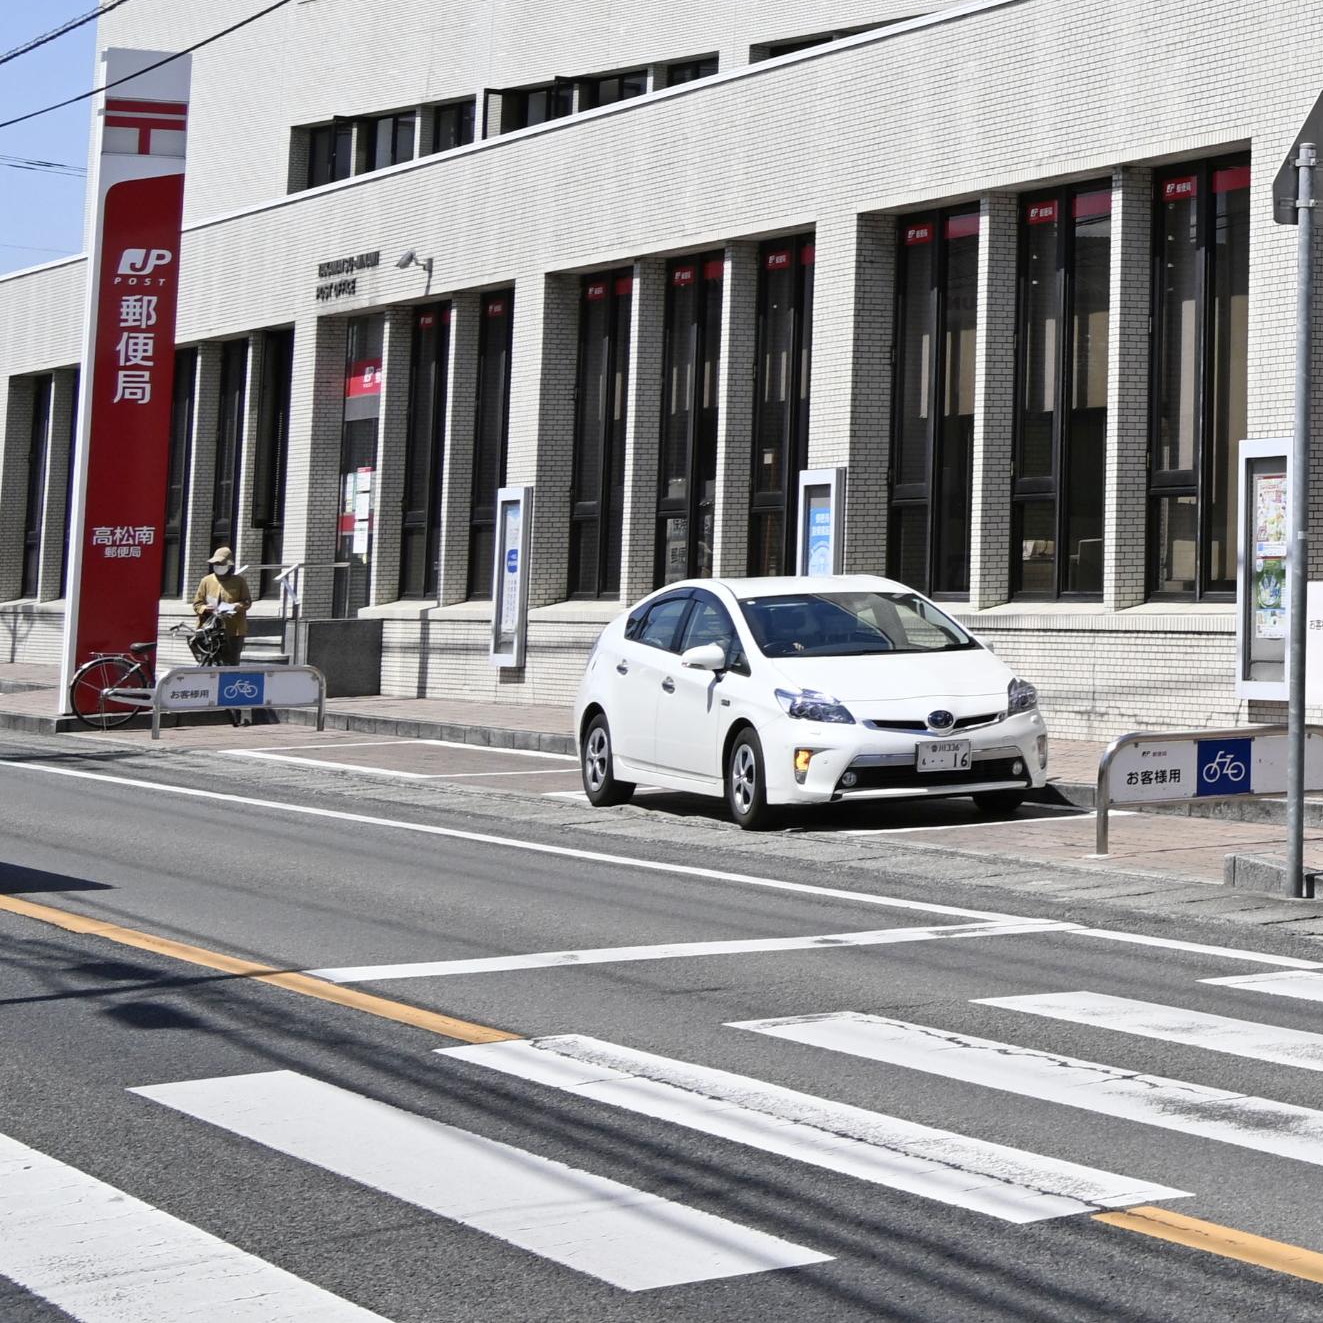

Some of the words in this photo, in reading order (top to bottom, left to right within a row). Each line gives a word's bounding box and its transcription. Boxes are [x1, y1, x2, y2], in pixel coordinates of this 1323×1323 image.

[117, 248, 172, 275] JP
[114, 277, 166, 287] POST
[113, 295, 158, 405] 郵便局
[92, 526, 155, 545] 高松南
[104, 546, 141, 558] 郵便局
[170, 689, 209, 700] お客様用
[953, 752, 968, 767] 16
[1126, 769, 1181, 785] お客様用
